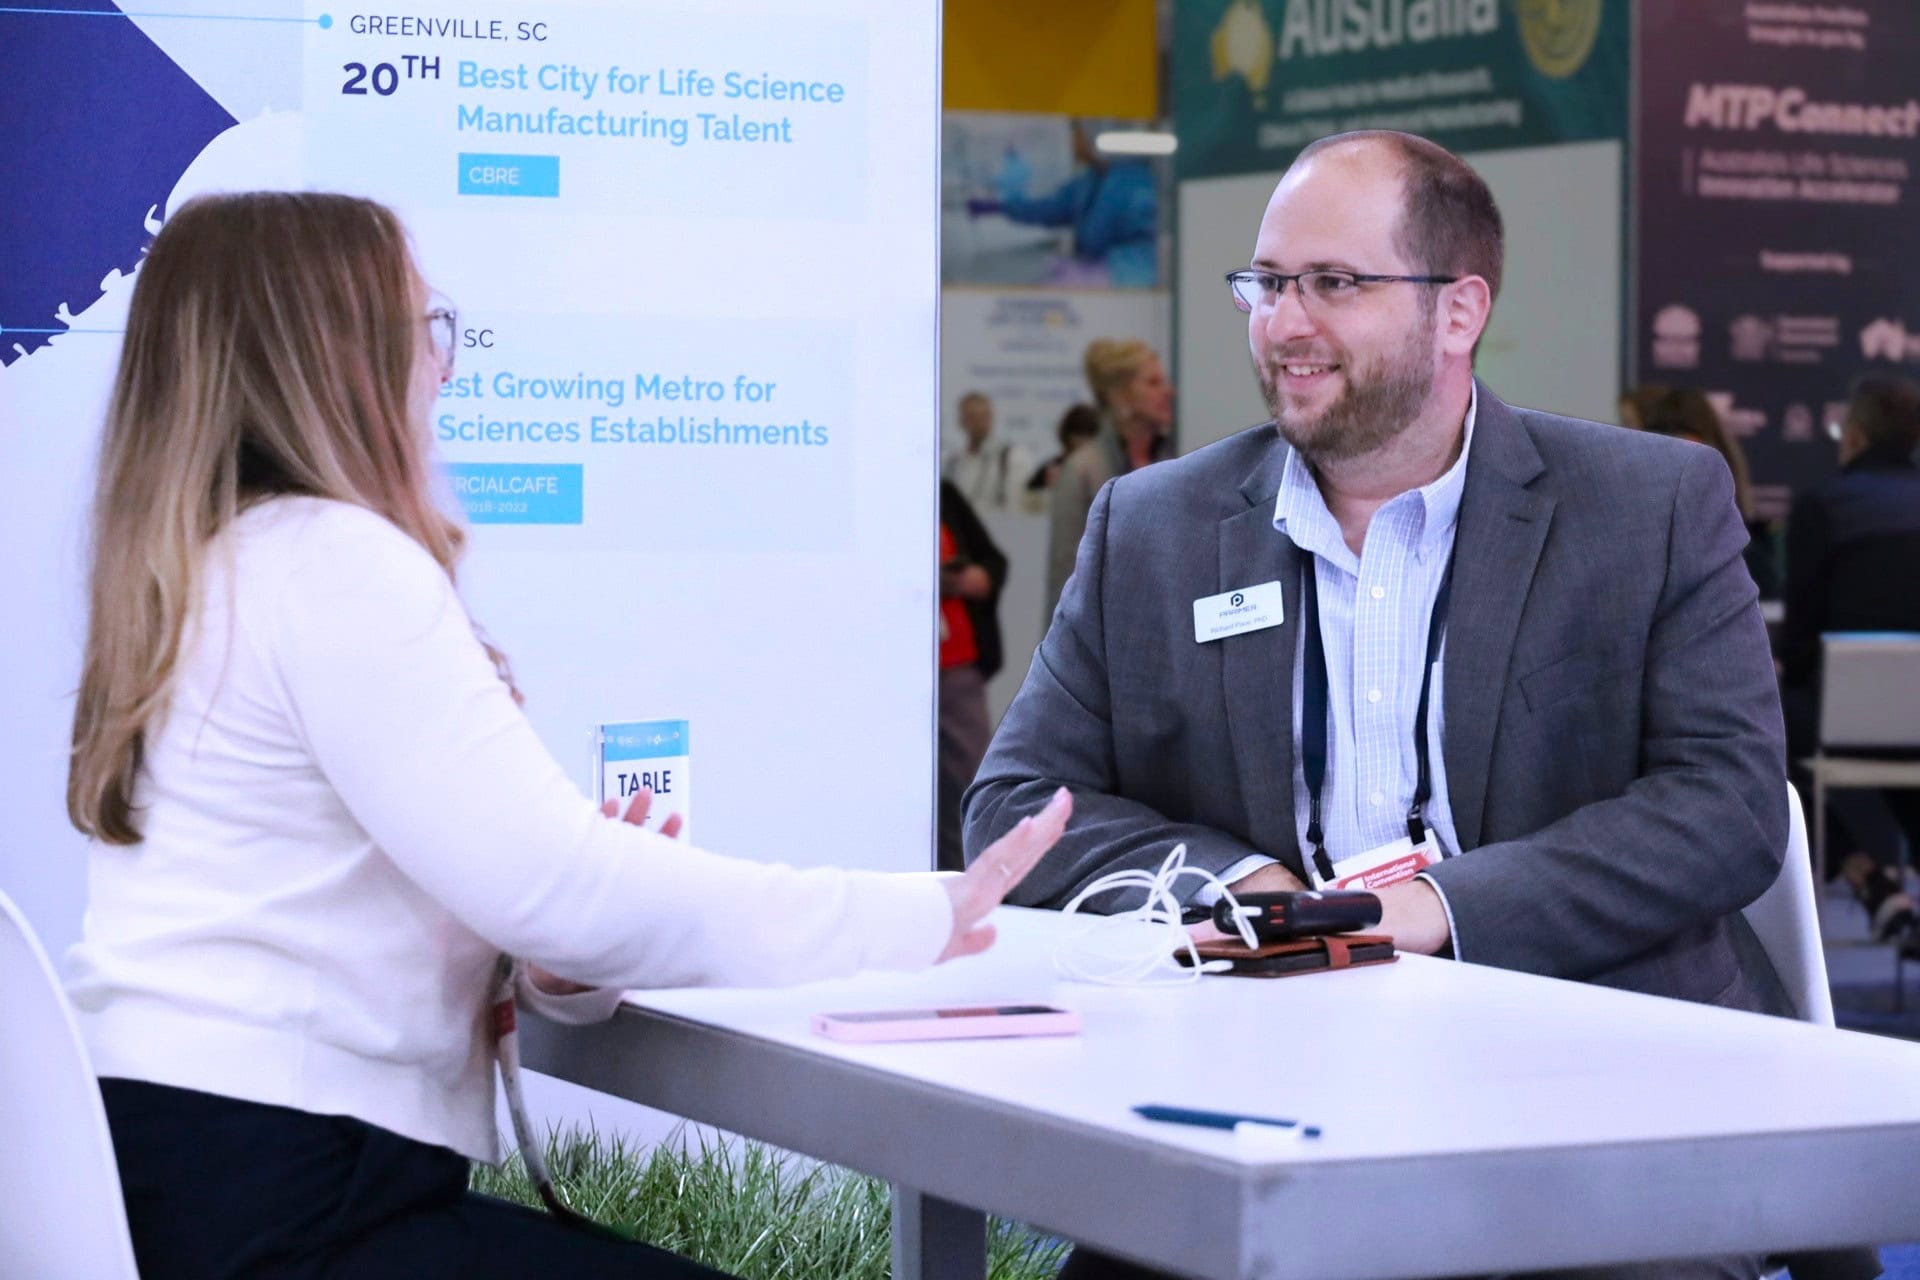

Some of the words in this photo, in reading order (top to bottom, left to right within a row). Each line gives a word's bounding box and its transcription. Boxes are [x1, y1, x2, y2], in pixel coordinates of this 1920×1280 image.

[350, 15, 509, 41] GREENVILLE,
[517, 21, 548, 42] SC
[457, 61, 529, 91] Best
[537, 63, 599, 100] City
[607, 66, 650, 95] for
[658, 68, 715, 97] Life
[723, 71, 845, 103] Science
[457, 104, 690, 146] Manufacturing
[696, 113, 793, 144] Talent
[468, 166, 520, 186] CBRE
[463, 329, 495, 349] SC
[439, 372, 484, 399] est
[492, 372, 626, 407] Growing
[634, 375, 725, 402] Metro
[733, 375, 777, 402] for
[437, 415, 581, 443] Sciences
[589, 416, 829, 446] Establishments
[454, 475, 559, 495] RCIALCAFE
[617, 770, 672, 797] TABLE
[1364, 858, 1417, 882] International
[1367, 868, 1415, 888] Convention
